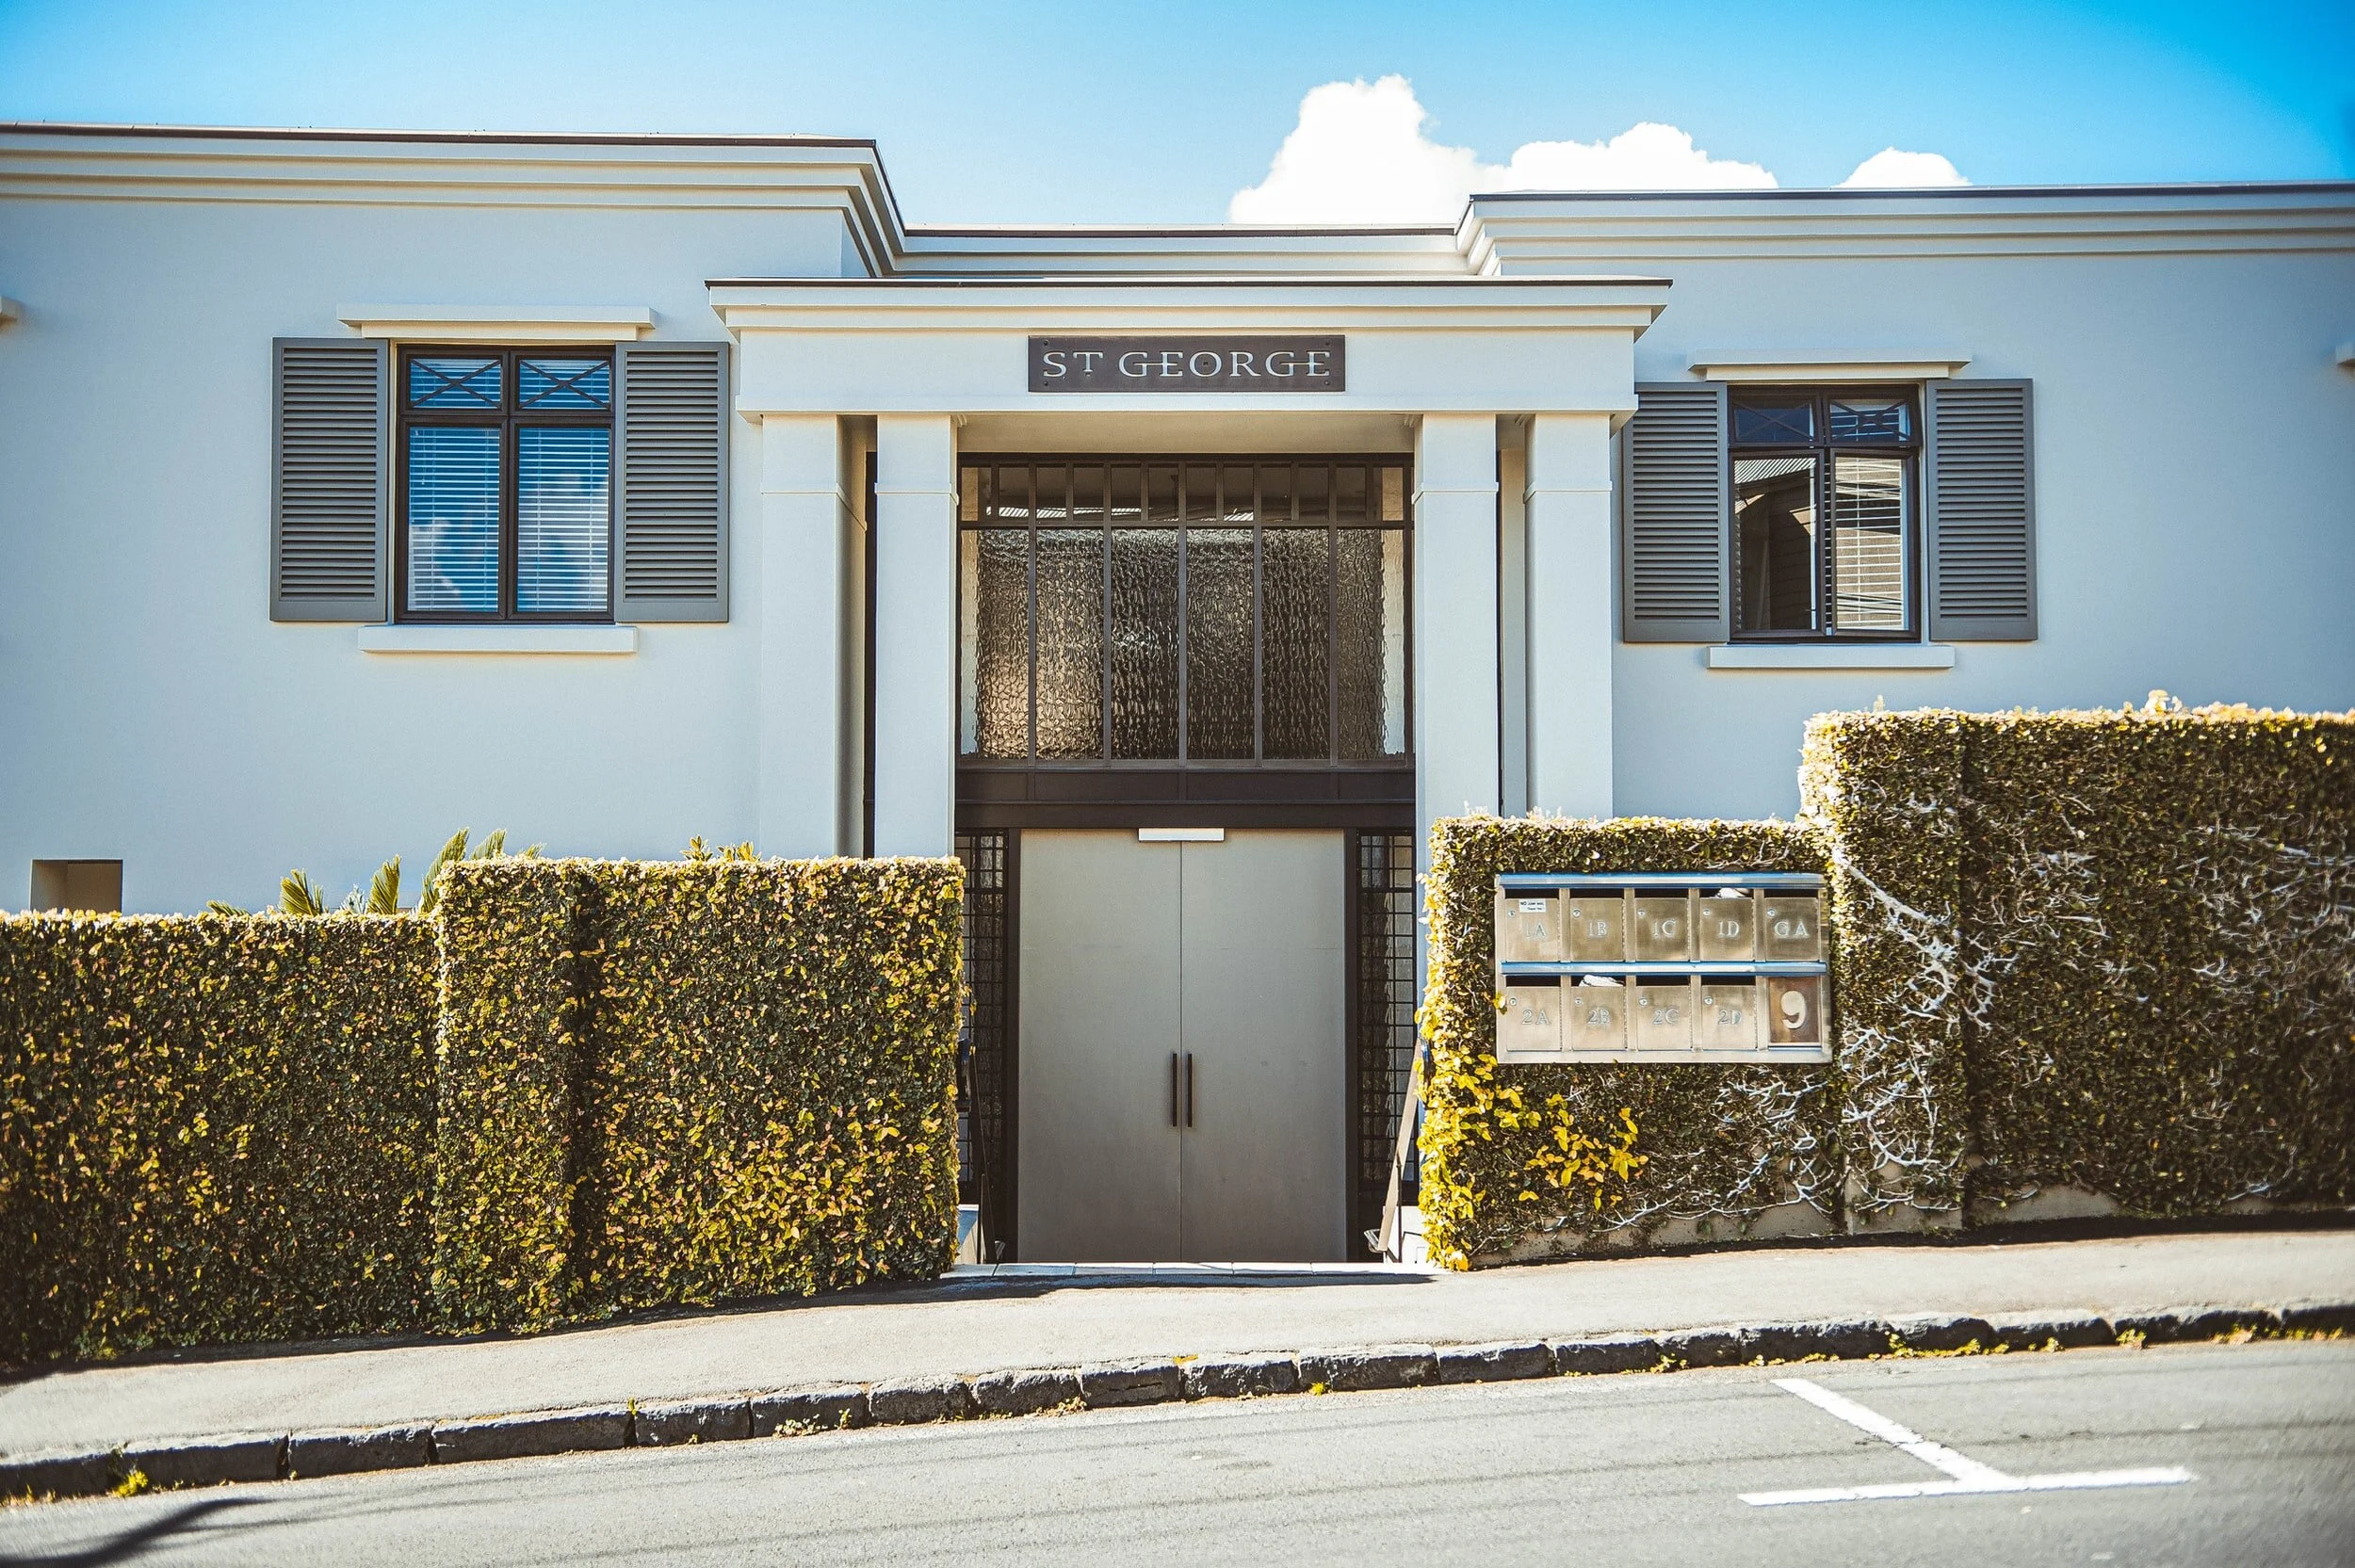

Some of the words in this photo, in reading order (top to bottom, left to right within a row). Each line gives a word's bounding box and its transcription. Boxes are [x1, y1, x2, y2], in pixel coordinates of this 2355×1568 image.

[1042, 351, 1104, 377] ST
[1118, 351, 1331, 378] GEORGE
[1525, 922, 1548, 938] 1A
[1588, 921, 1608, 937] 1B
[1652, 919, 1677, 938] 1C
[1718, 920, 1740, 937] 1D
[1521, 1009, 1551, 1026] 2A
[1587, 1009, 1612, 1025] 2B
[1652, 1009, 1679, 1025] 2C
[1717, 1009, 1742, 1025] 2D
[1780, 990, 1807, 1029] 9
